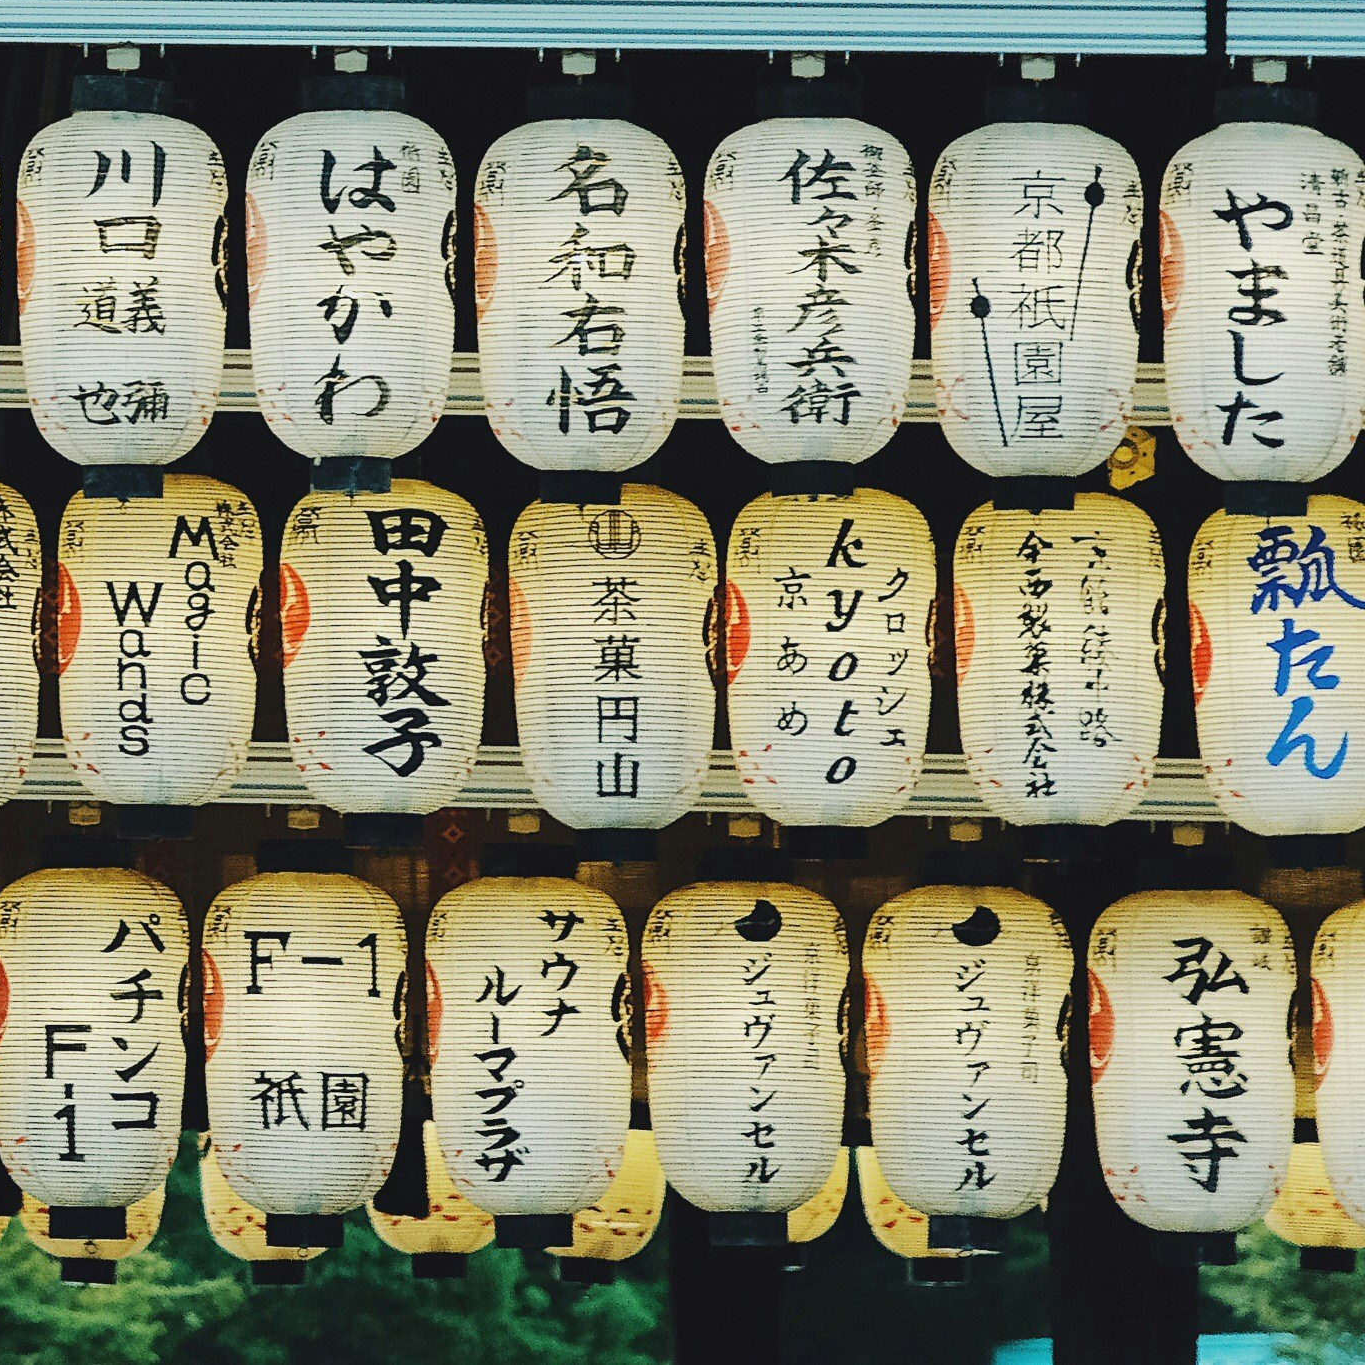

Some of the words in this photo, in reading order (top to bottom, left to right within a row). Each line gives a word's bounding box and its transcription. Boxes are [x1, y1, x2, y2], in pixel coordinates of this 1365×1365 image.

[85, 140, 167, 261] 川口
[313, 145, 399, 426] はやかわ
[1008, 169, 1069, 441] 京都祇園屋
[1212, 188, 1295, 450] やました
[105, 581, 165, 757] Wands
[167, 514, 221, 706] Magic
[357, 507, 453, 779] 田中敦子
[590, 576, 644, 800] 茶菓円山
[773, 566, 810, 737] 京あめ
[873, 566, 911, 747] クロッシェ
[1244, 523, 1365, 781] 瓢たん
[100, 912, 167, 1131] パチンコ
[243, 930, 382, 998] F-1
[472, 964, 531, 1183] ルーマプラザ
[537, 908, 586, 1037] サウナ
[741, 953, 781, 1185] ジュヴァンセル
[1161, 936, 1251, 1193] 弘憲寺
[250, 1070, 370, 1133] 祇園
[953, 957, 997, 1193] ジュヴァンセル
